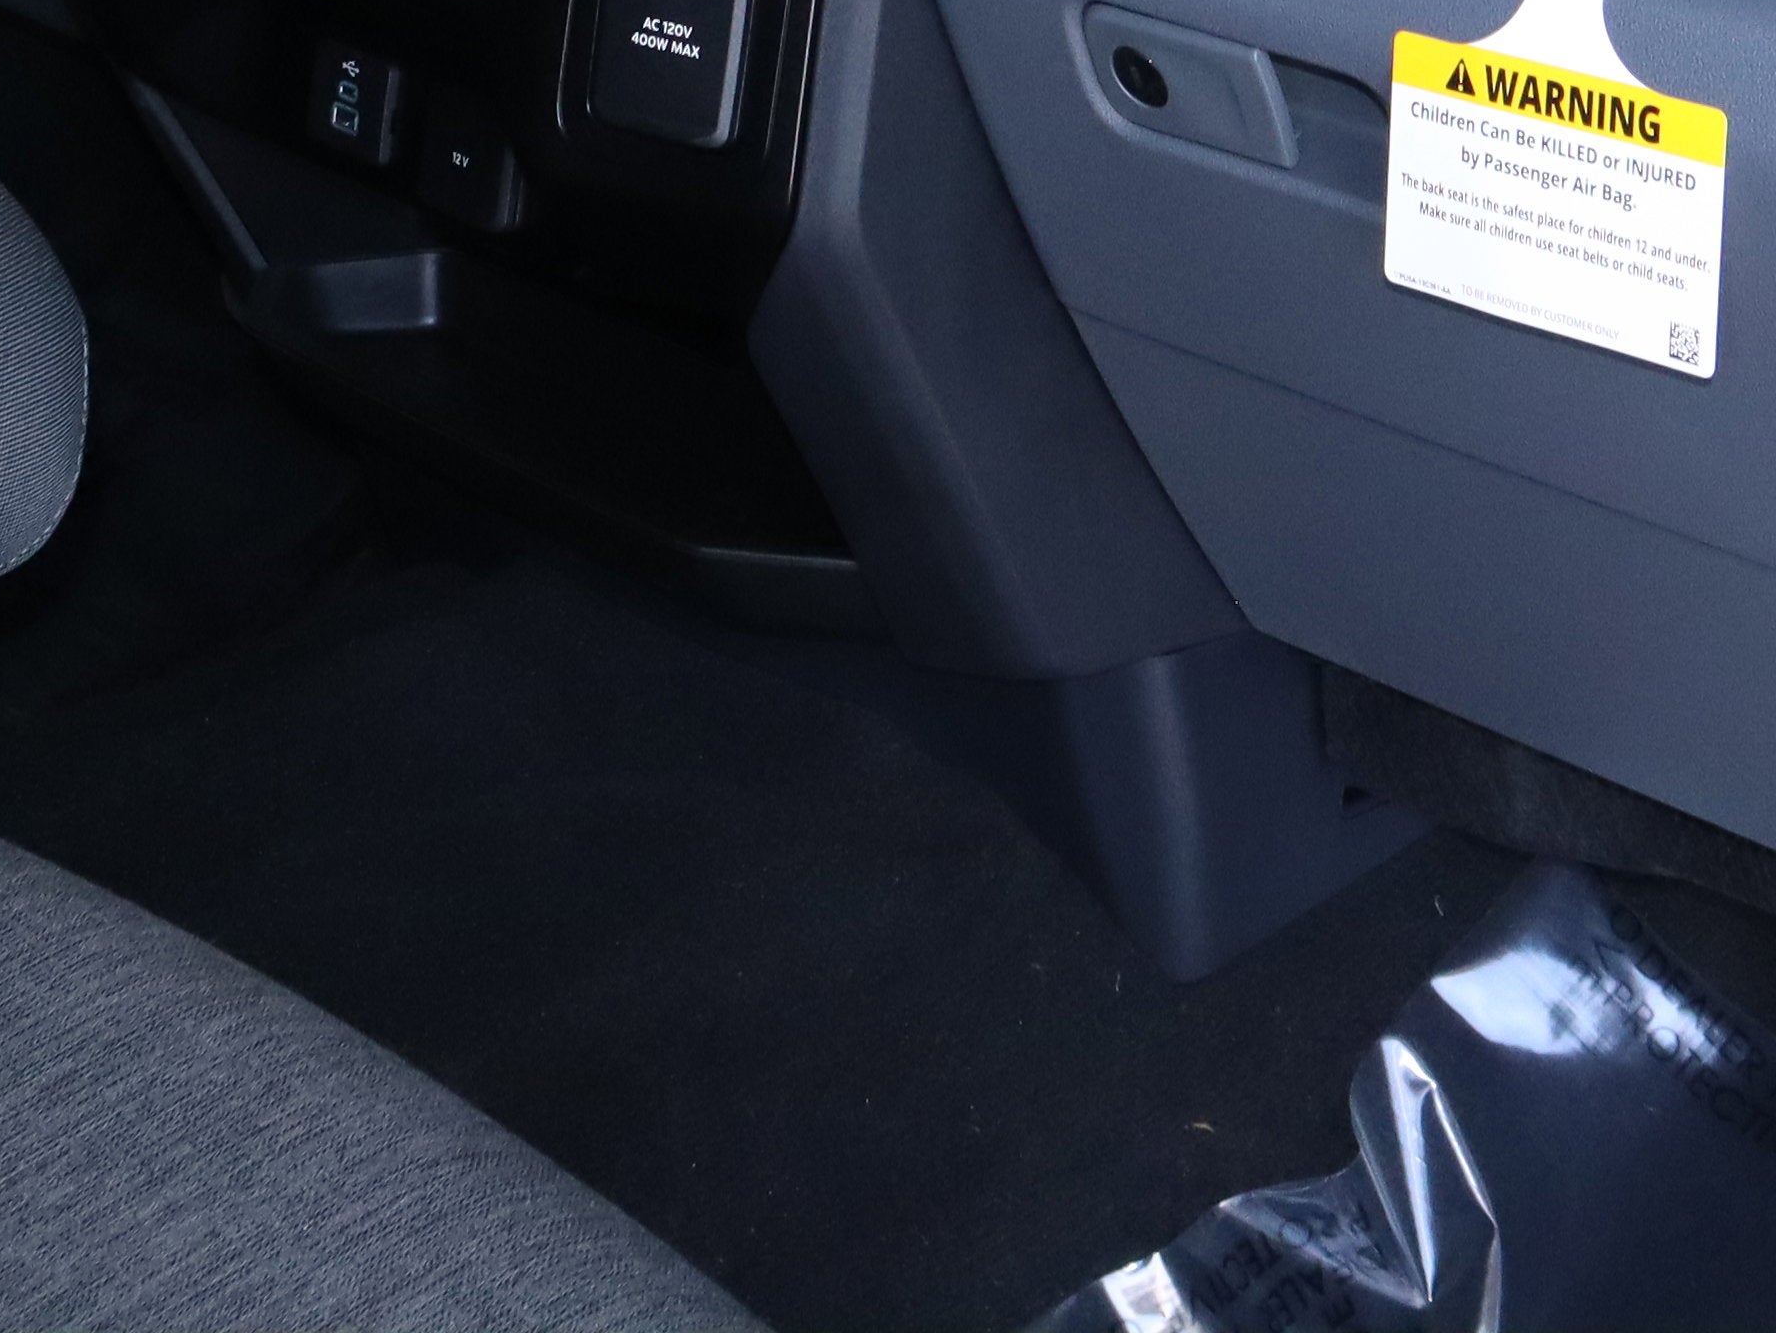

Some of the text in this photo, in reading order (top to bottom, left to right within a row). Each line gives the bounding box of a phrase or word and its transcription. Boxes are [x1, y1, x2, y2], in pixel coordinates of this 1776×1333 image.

[631, 31, 701, 60] 400W MAX
[643, 16, 693, 39] AC 120V
[1484, 63, 1662, 144] WARNING
[452, 151, 470, 168] 12 V
[1410, 100, 1696, 194] Children Can Be KILLED or INJURED
[1461, 145, 1637, 213] by Passenger Air Bag.
[1401, 172, 1710, 273] The back seat is the safest place for children 12 and under.
[1419, 201, 1688, 292] Make sure all children use seat belts or child seats.
